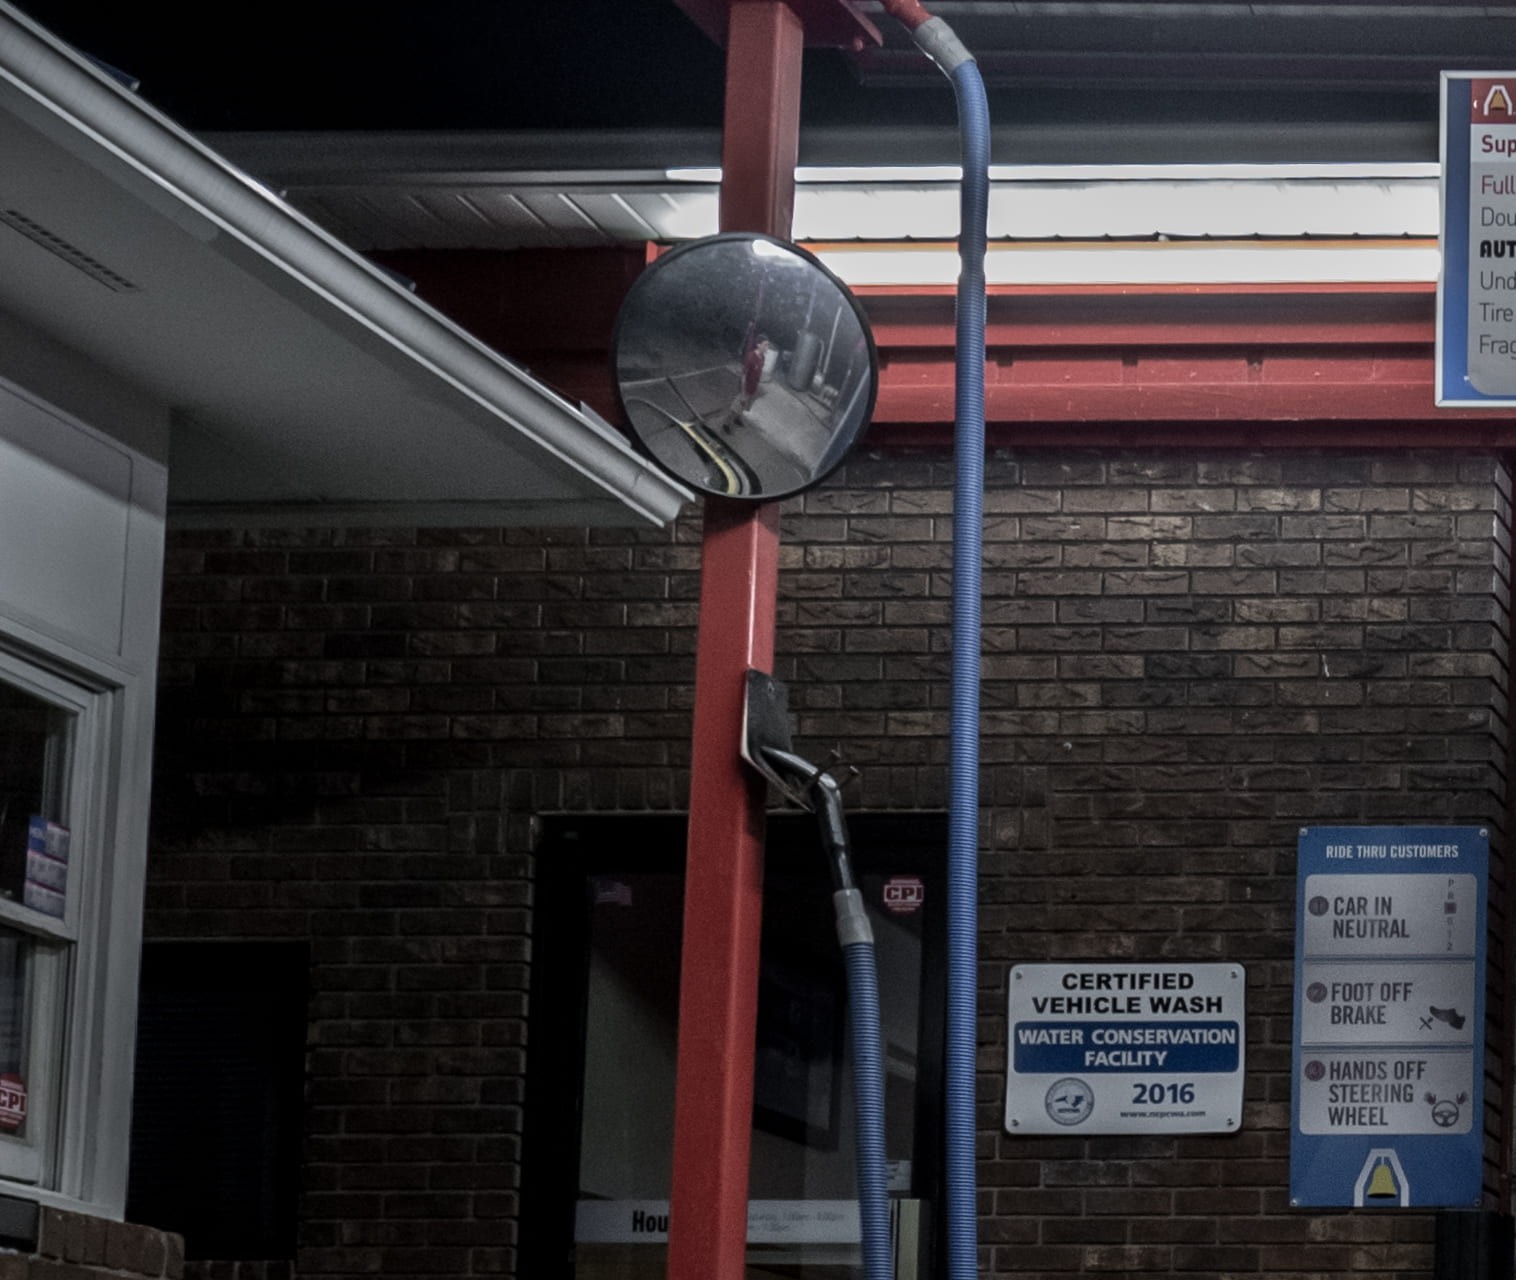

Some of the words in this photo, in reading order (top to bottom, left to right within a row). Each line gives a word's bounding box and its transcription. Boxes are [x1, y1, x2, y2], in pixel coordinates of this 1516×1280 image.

[1481, 176, 1515, 195] Full
[1480, 303, 1514, 321] Tire
[1326, 845, 1353, 859] RIDE
[1358, 845, 1386, 858] THRU
[1391, 845, 1458, 858] CUSTOMERS
[887, 887, 922, 900] CPI
[1333, 896, 1370, 916] CAR
[1374, 896, 1391, 915] IN
[1333, 919, 1410, 938] NEUTRAL
[1062, 973, 1193, 990] CERTIFIED
[1332, 983, 1373, 1002] FOOT
[1381, 982, 1412, 1001] OFF
[1033, 998, 1141, 1014] VEHICLE
[1150, 997, 1222, 1013] WASH
[1331, 1006, 1386, 1024] BRAKE
[1018, 1030, 1083, 1044] WATER
[1092, 1029, 1235, 1044] CONSERVATION
[1085, 1052, 1167, 1066] FACILITY
[1330, 1062, 1387, 1080] HANDS
[1394, 1061, 1426, 1079] OFF
[1132, 1084, 1194, 1104] 2016
[1329, 1085, 1413, 1103] STEERING
[1329, 1107, 1388, 1126] WHEEL
[633, 1211, 669, 1232] Hou
